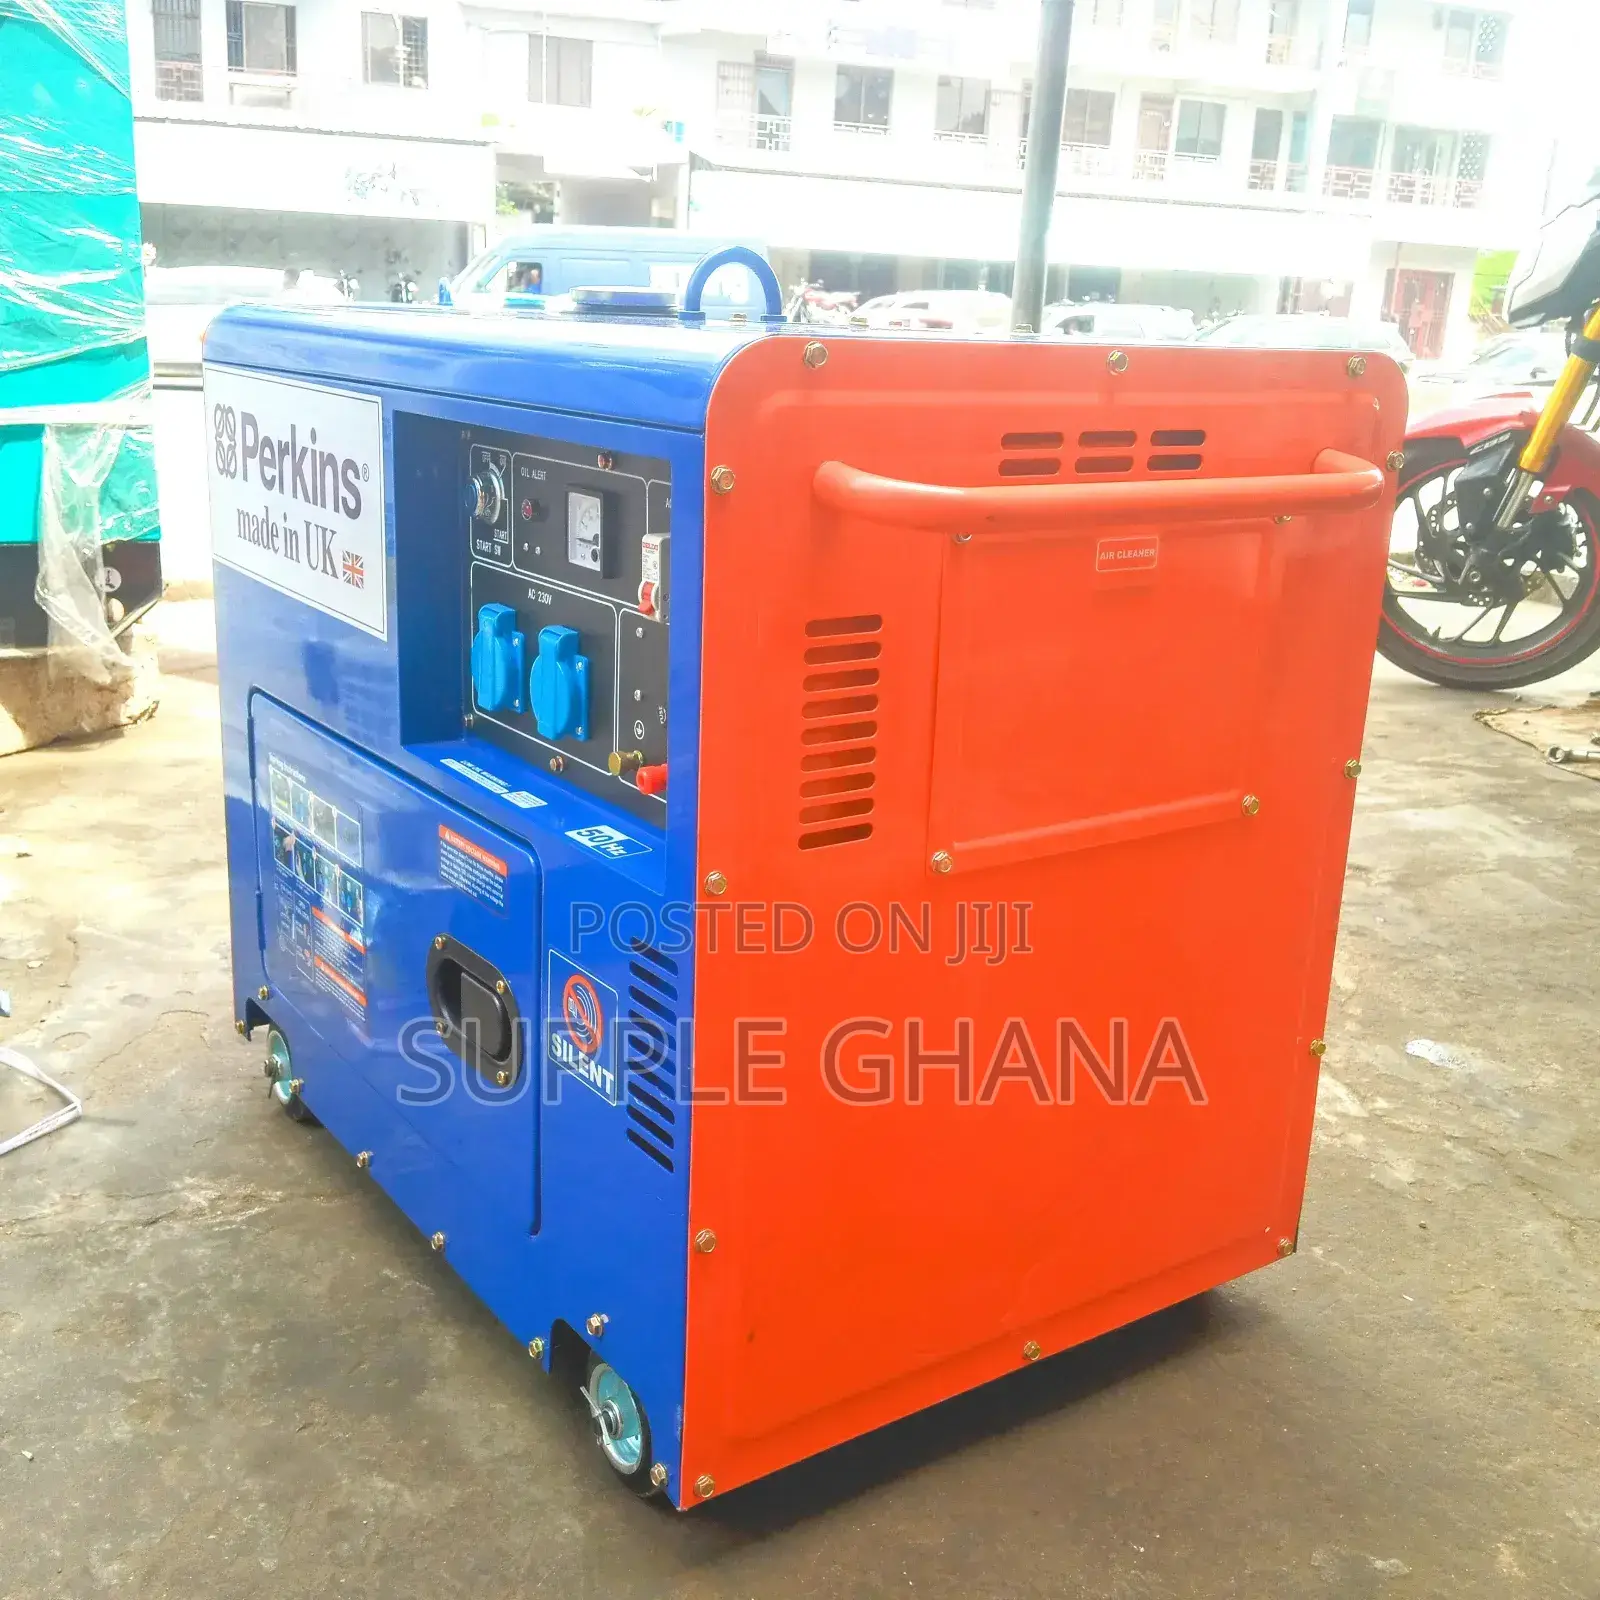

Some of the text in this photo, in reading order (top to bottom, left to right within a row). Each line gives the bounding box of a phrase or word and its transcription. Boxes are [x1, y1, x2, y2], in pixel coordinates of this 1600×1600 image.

[520, 467, 547, 481] OIL ALERT
[493, 528, 507, 541] START
[237, 505, 339, 580] made in UK
[476, 539, 492, 553] START
[1100, 548, 1156, 560] AIR CLEANER
[528, 588, 552, 606] AC 230V
[551, 1032, 615, 1095] SILENT
